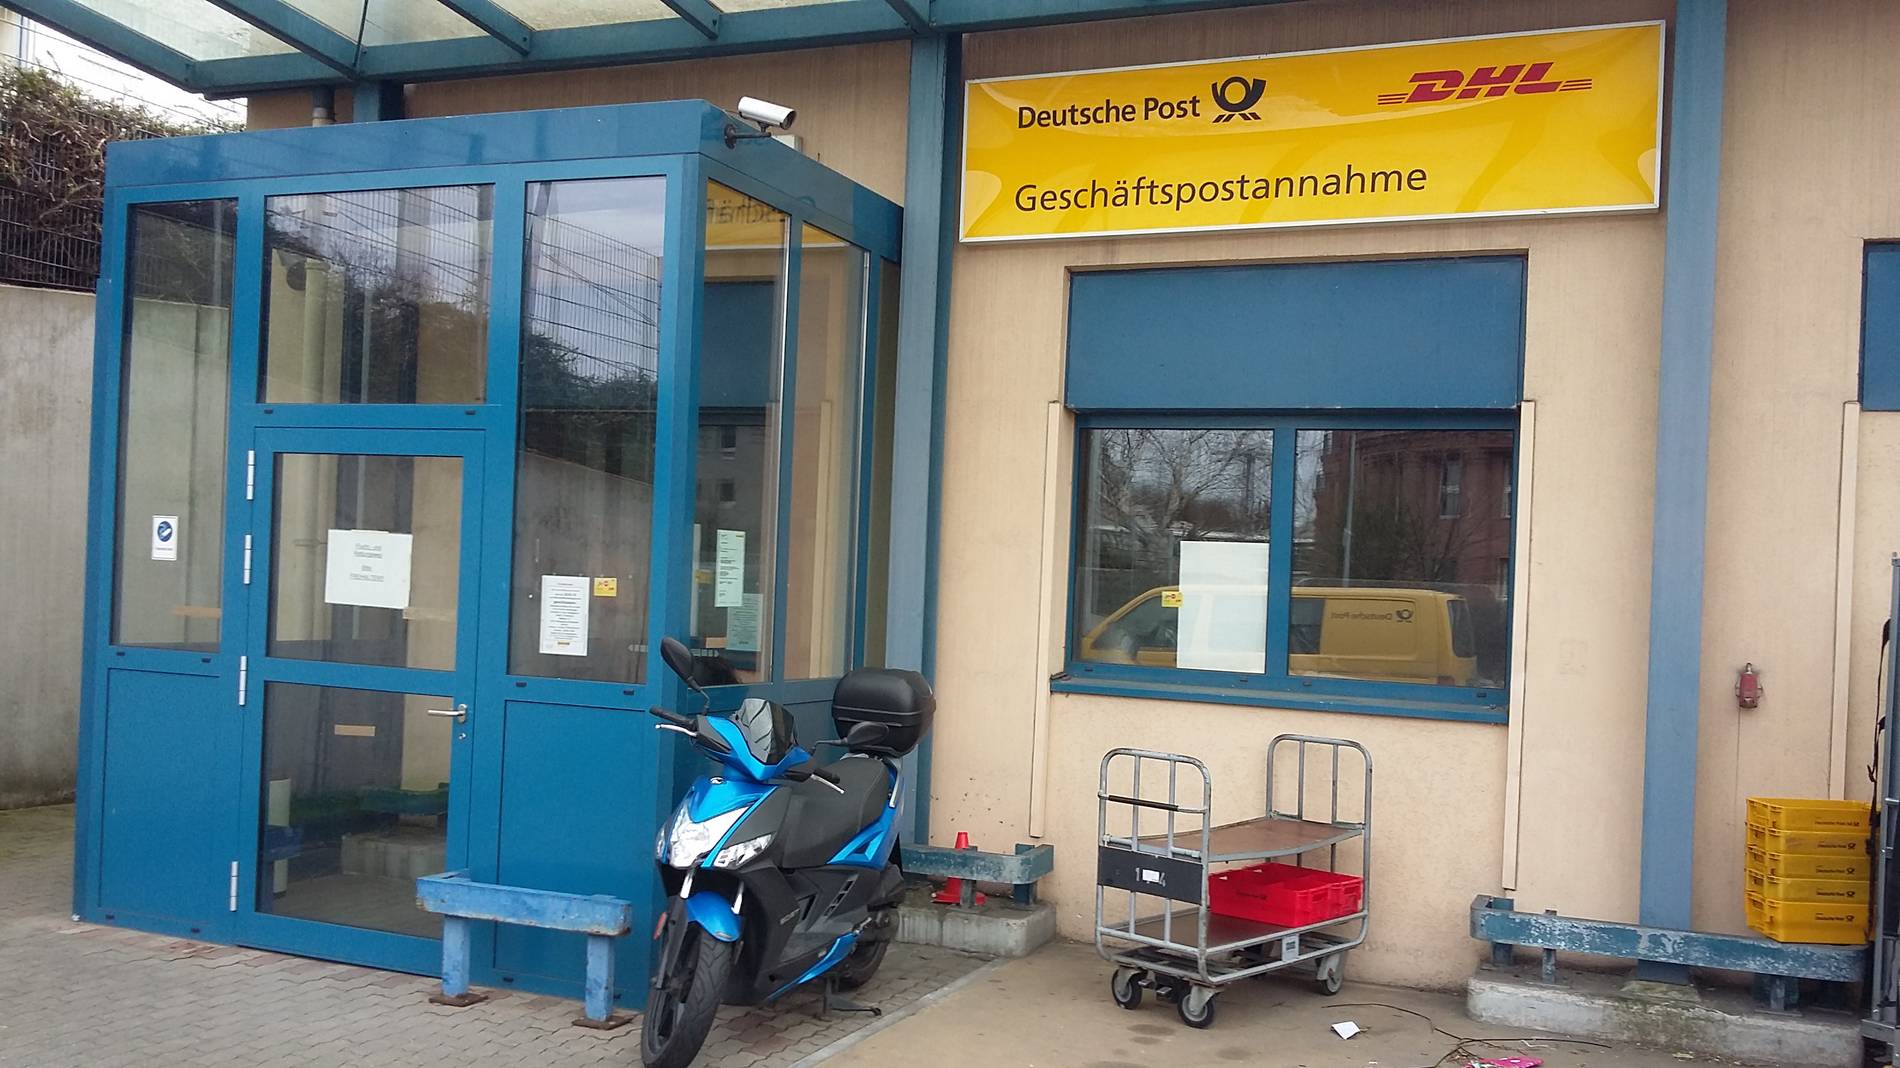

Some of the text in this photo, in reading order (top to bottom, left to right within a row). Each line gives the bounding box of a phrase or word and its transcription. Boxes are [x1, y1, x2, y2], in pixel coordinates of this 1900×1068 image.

[1406, 61, 1564, 104] DHL
[1018, 95, 1201, 129] Deutsche Post
[1014, 164, 1428, 212] Geschäftspostannahme
[1135, 867, 1166, 887] 14
